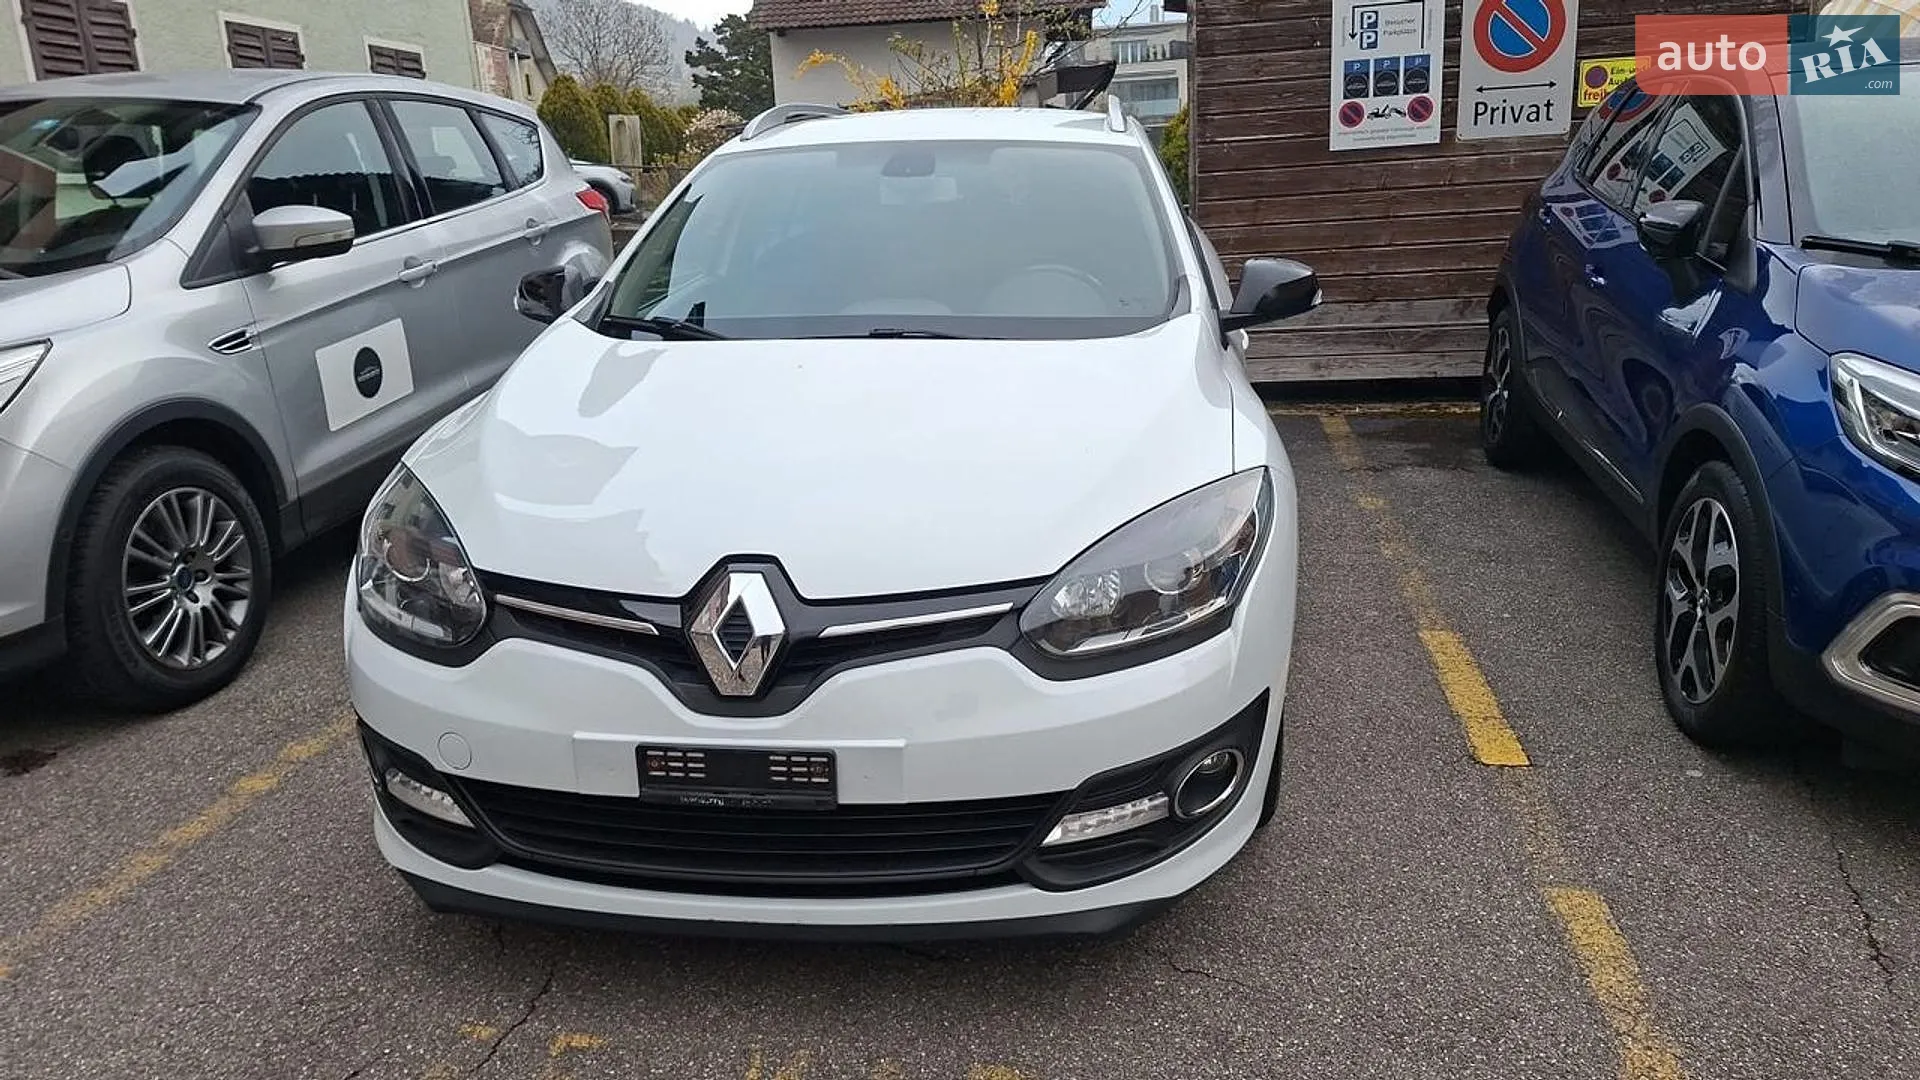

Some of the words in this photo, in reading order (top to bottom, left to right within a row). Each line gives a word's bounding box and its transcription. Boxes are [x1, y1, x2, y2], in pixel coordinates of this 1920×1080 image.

[1362, 12, 1376, 28] P
[1362, 32, 1376, 49] P
[1473, 98, 1554, 126] Privat
